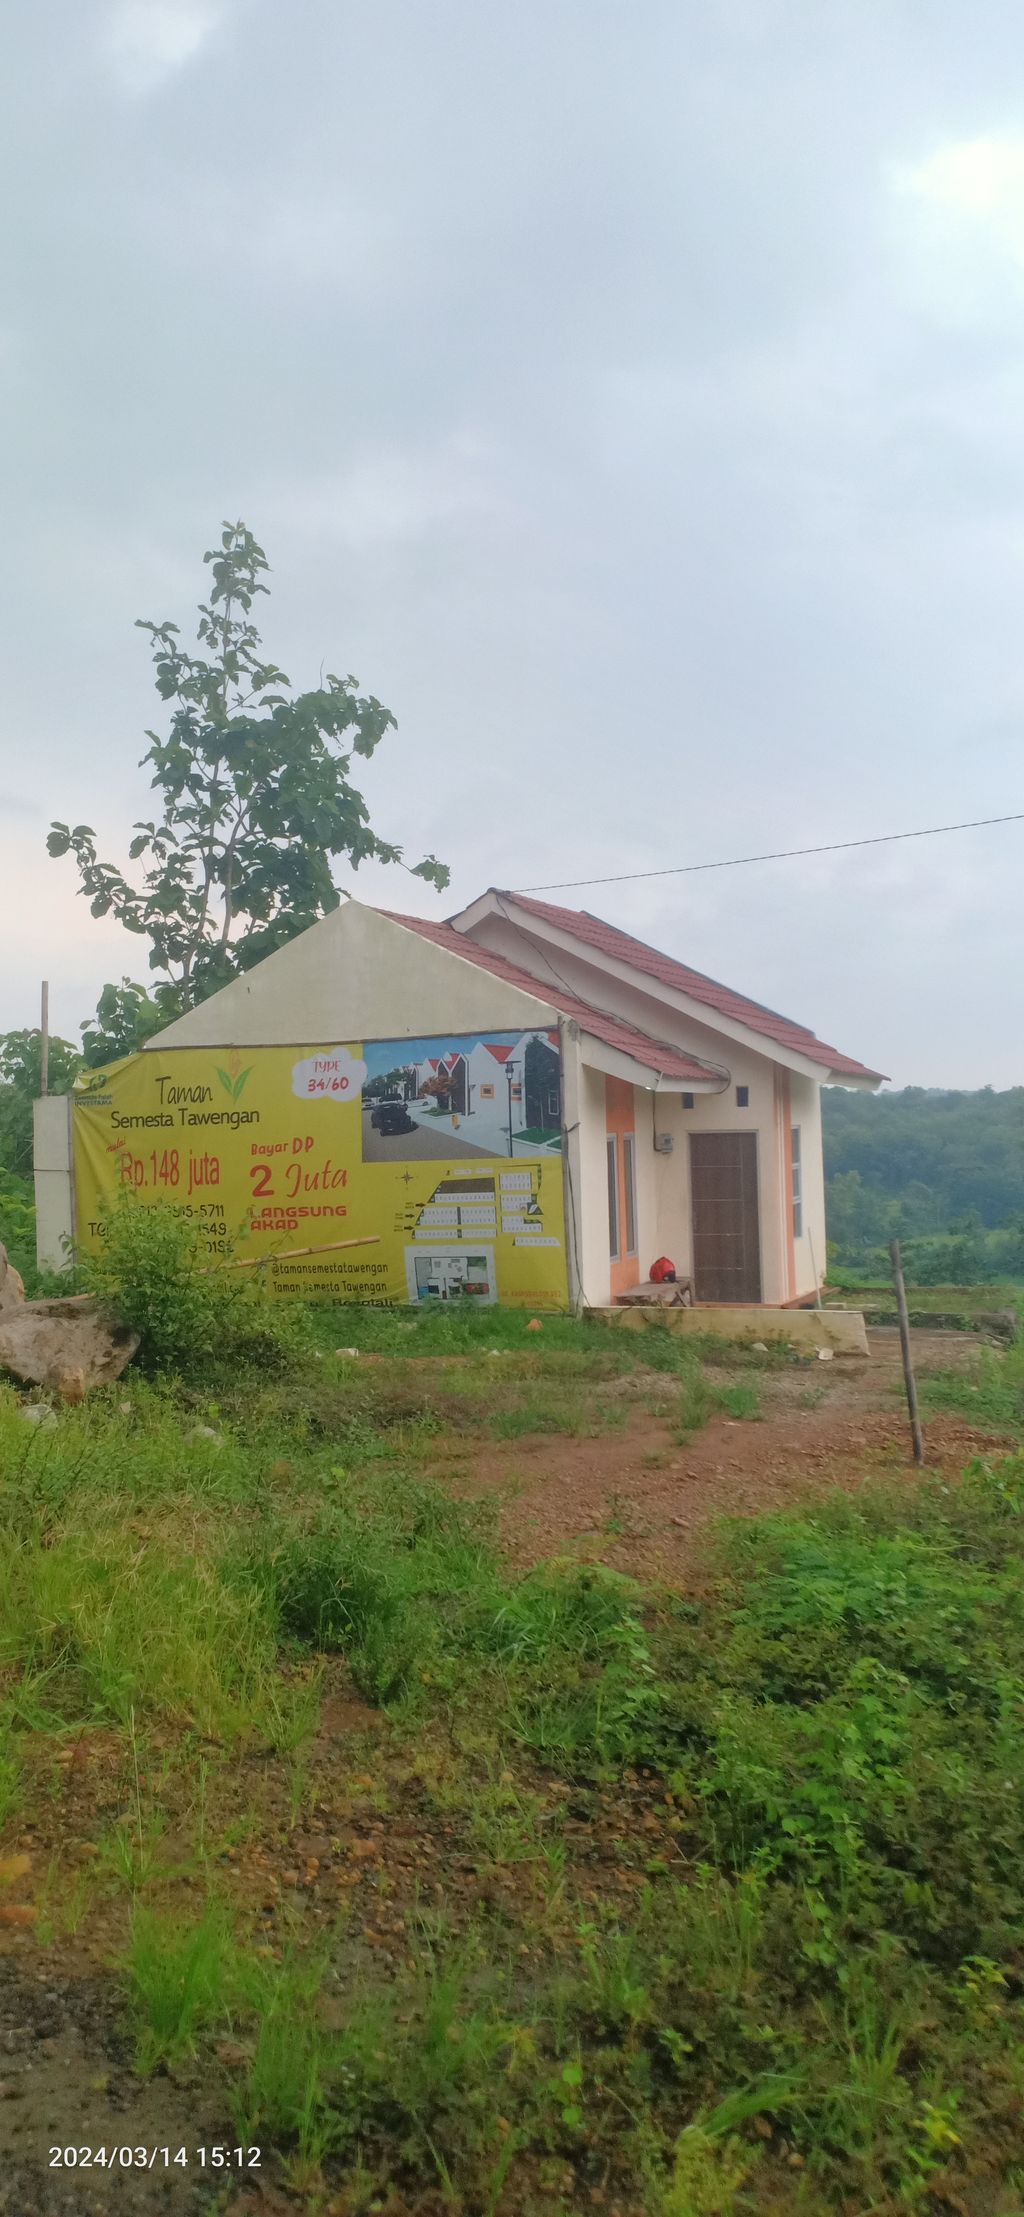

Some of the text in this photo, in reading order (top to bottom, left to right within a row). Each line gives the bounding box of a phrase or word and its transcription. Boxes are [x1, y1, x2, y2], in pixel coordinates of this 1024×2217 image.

[312, 1060, 342, 1073] TYPE
[155, 1076, 213, 1105] Taman
[308, 1077, 349, 1092] 34/60
[111, 1108, 260, 1130] Semesta Tawengan
[251, 1136, 314, 1157] Bayar DP
[187, 1149, 219, 1196] juta
[250, 1160, 348, 1198] 2 Juta
[251, 1219, 298, 1231] AKAD
[271, 1262, 388, 1277] @tamansemestatawengan
[272, 1281, 300, 1293] Taman
[341, 1281, 387, 1295] Tawengan
